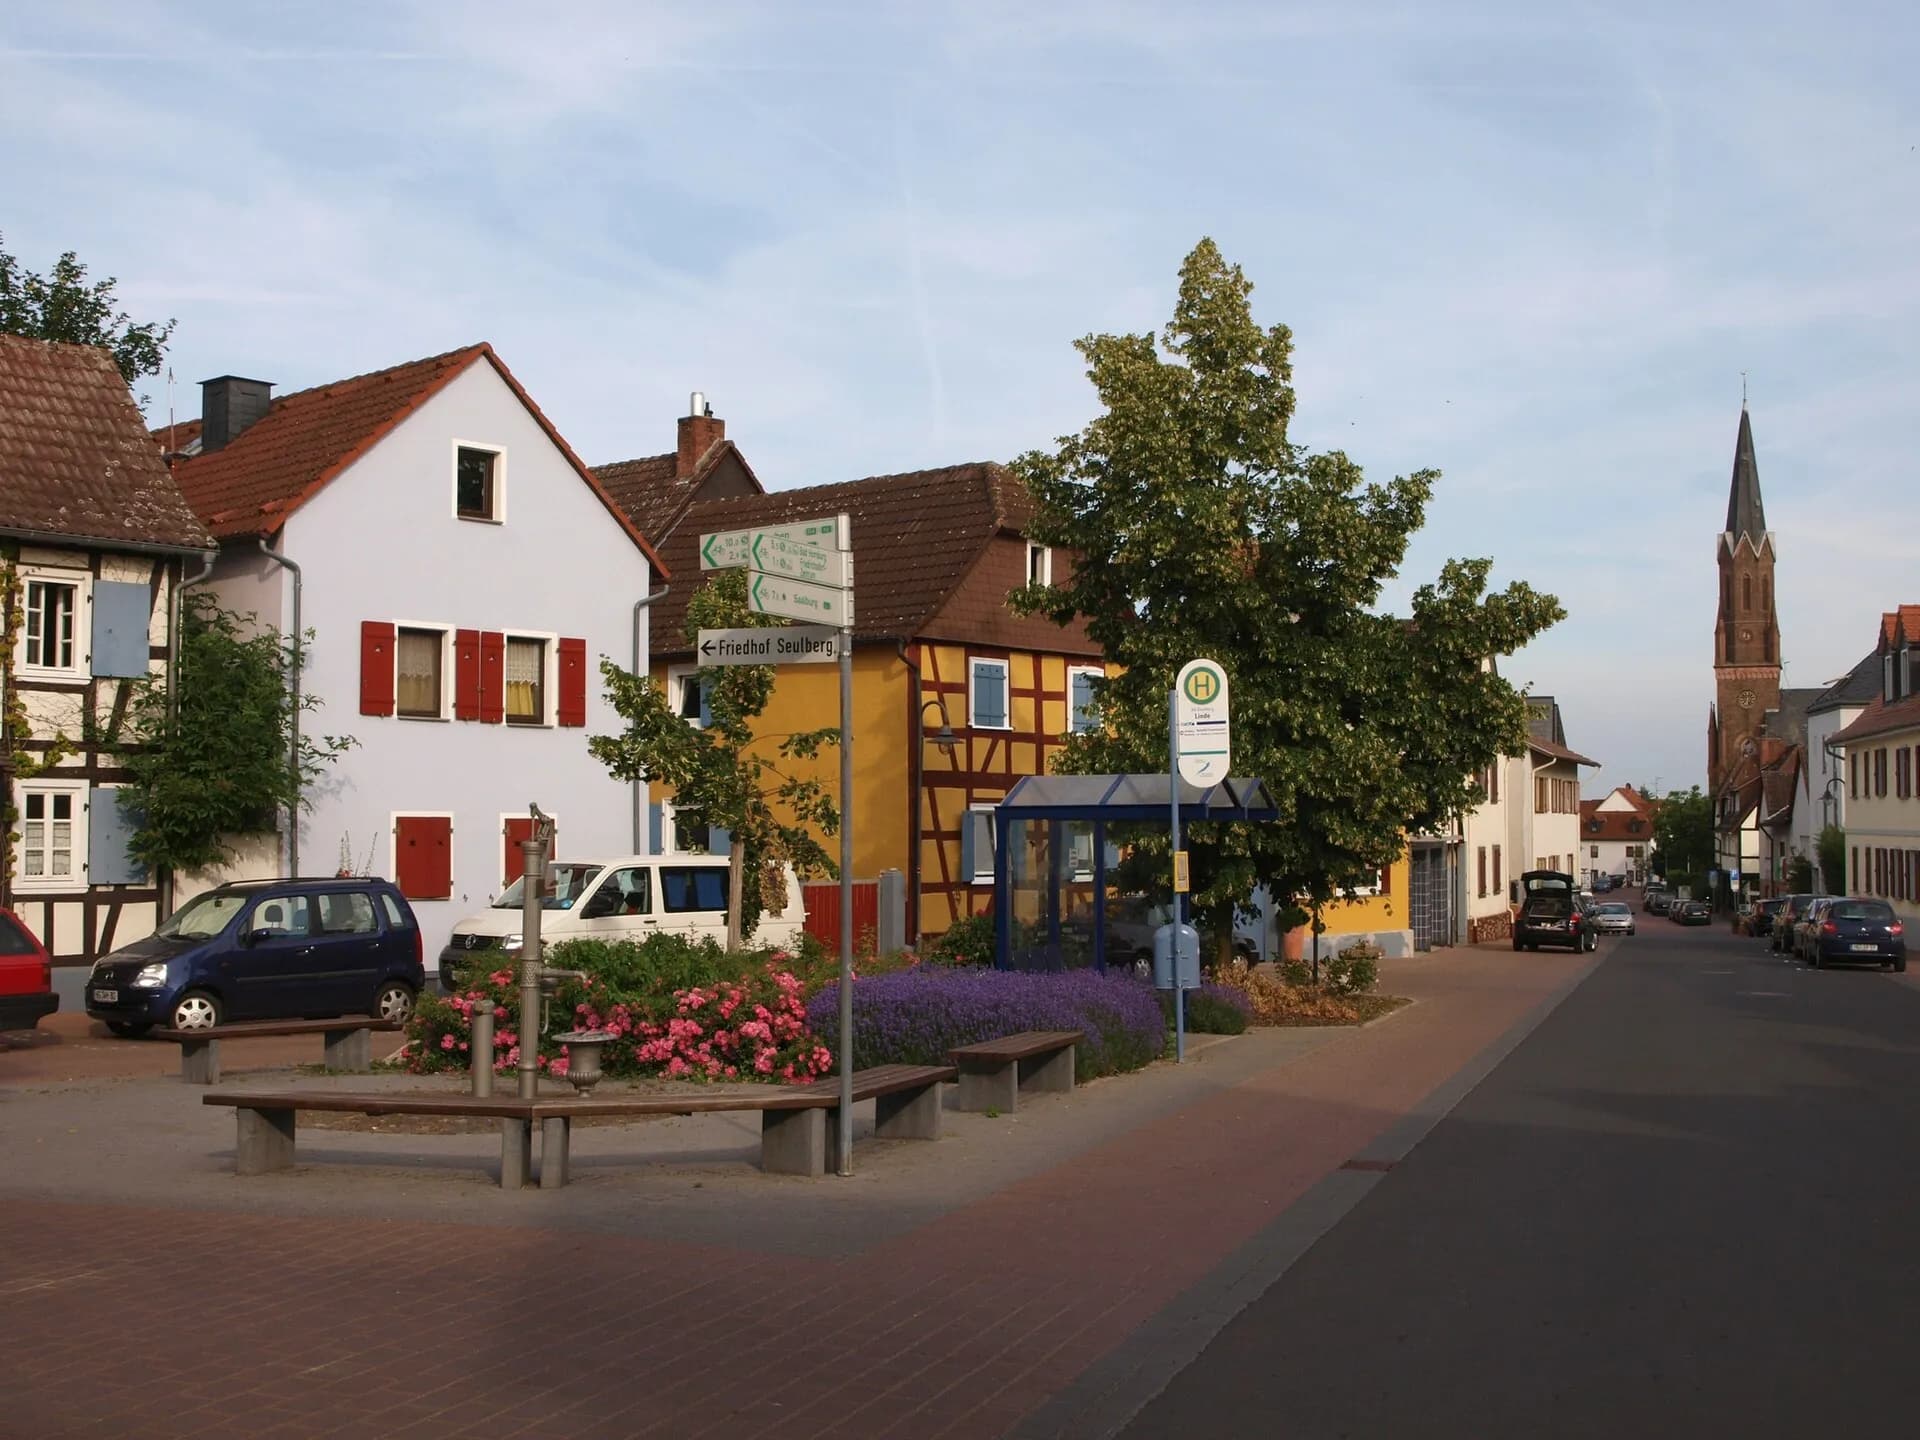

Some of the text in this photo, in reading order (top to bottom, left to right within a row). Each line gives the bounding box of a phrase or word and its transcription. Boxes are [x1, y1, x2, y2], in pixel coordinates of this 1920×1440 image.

[719, 637, 834, 657] Friedhof Seulberg
[1194, 674, 1210, 697] H
